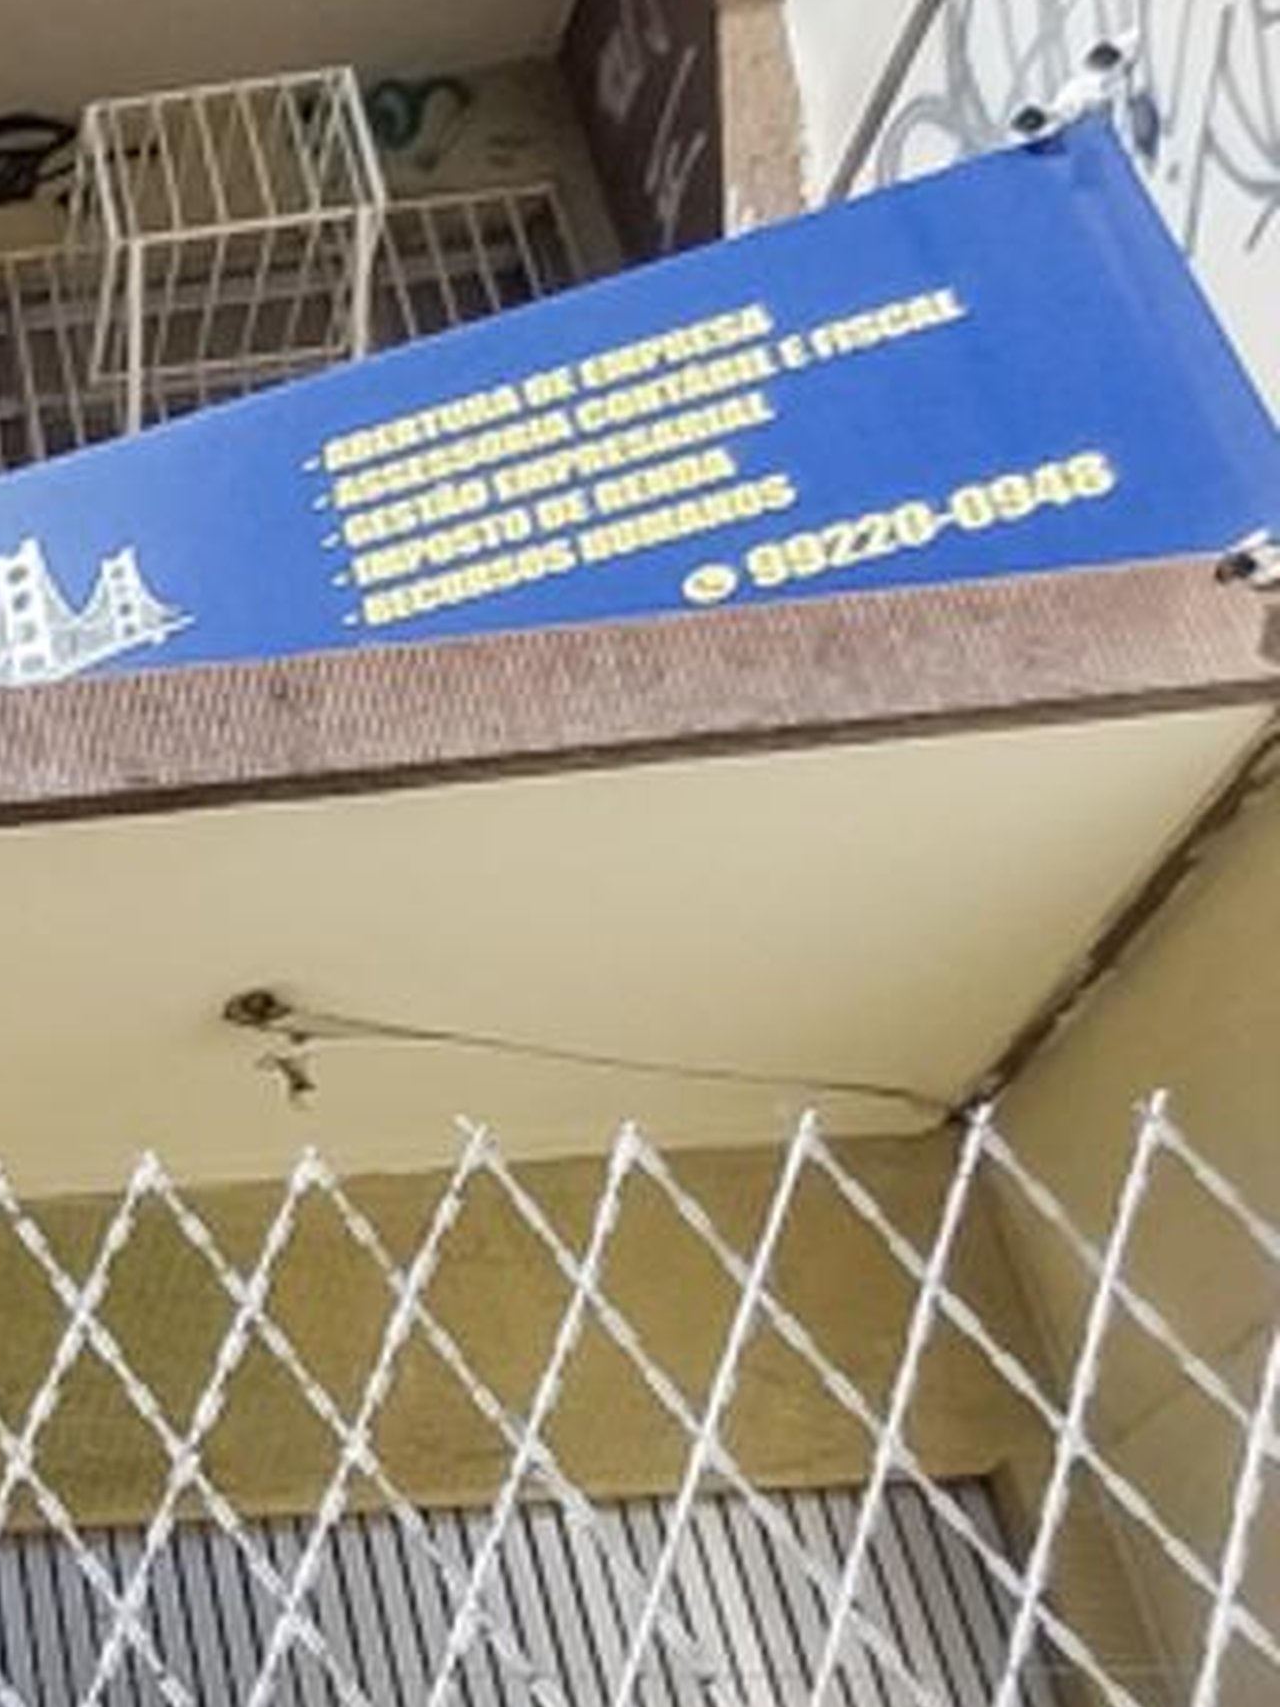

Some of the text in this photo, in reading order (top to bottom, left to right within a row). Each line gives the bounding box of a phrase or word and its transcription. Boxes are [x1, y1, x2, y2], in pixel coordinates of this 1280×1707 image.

[580, 302, 774, 386] EMPRESA
[812, 289, 968, 359] FISCAL
[353, 511, 532, 586] IMPOSTO
[593, 446, 737, 515] RENDA
[579, 473, 797, 561] HUMANOS
[748, 451, 1116, 585] 99220-0948
